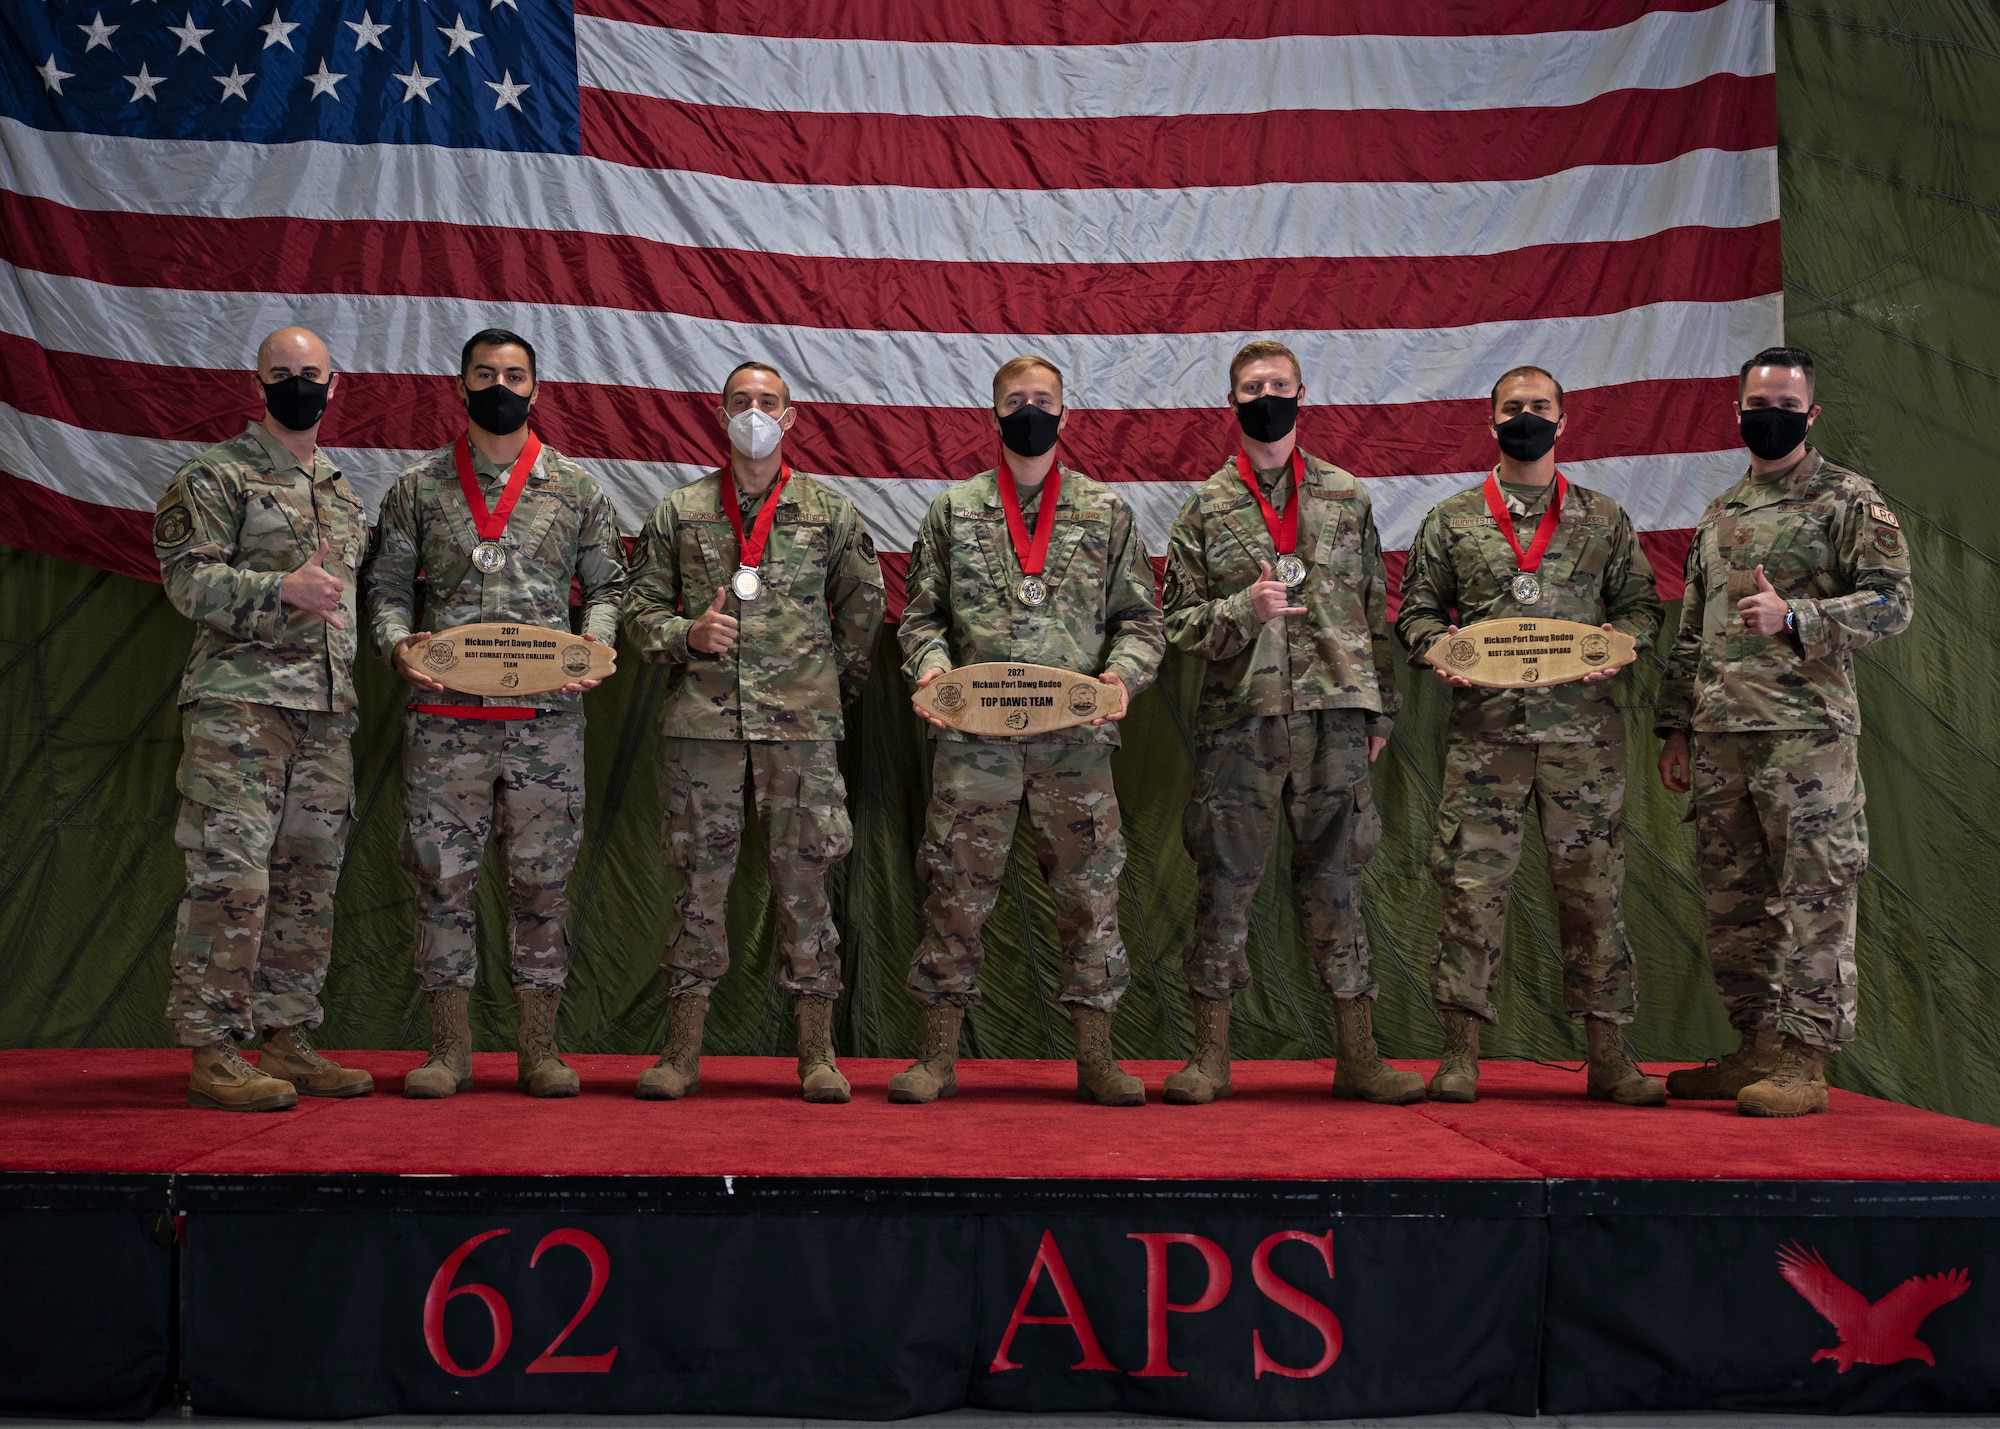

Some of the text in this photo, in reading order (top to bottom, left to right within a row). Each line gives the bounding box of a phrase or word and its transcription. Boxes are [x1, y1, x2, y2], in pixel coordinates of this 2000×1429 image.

[1872, 506, 1896, 525] LRO
[501, 627, 520, 636] 2021
[1518, 623, 1537, 632] 2021
[464, 637, 557, 649] Hickam Port Dawg Rodeo
[1484, 636, 1512, 645] Hickam
[1512, 635, 1528, 643] Port
[1530, 634, 1550, 643] Dawg
[1550, 633, 1574, 642] Rodeo
[479, 651, 502, 659] COMBAT
[503, 652, 525, 660] FITNESS
[1503, 649, 1515, 657] 25K
[1515, 648, 1549, 656] HALVERSON
[1549, 647, 1572, 655] UPLOAD
[1522, 657, 1538, 665] TEAM
[1007, 668, 1025, 677] 2021
[972, 680, 1000, 689] Hickam
[1001, 680, 1017, 689] Port
[1017, 680, 1037, 689] Dawg
[1038, 680, 1062, 689] Rodeo
[980, 696, 1054, 707] TOP DAWG TEAM
[422, 1227, 1343, 1380] 62 APS
